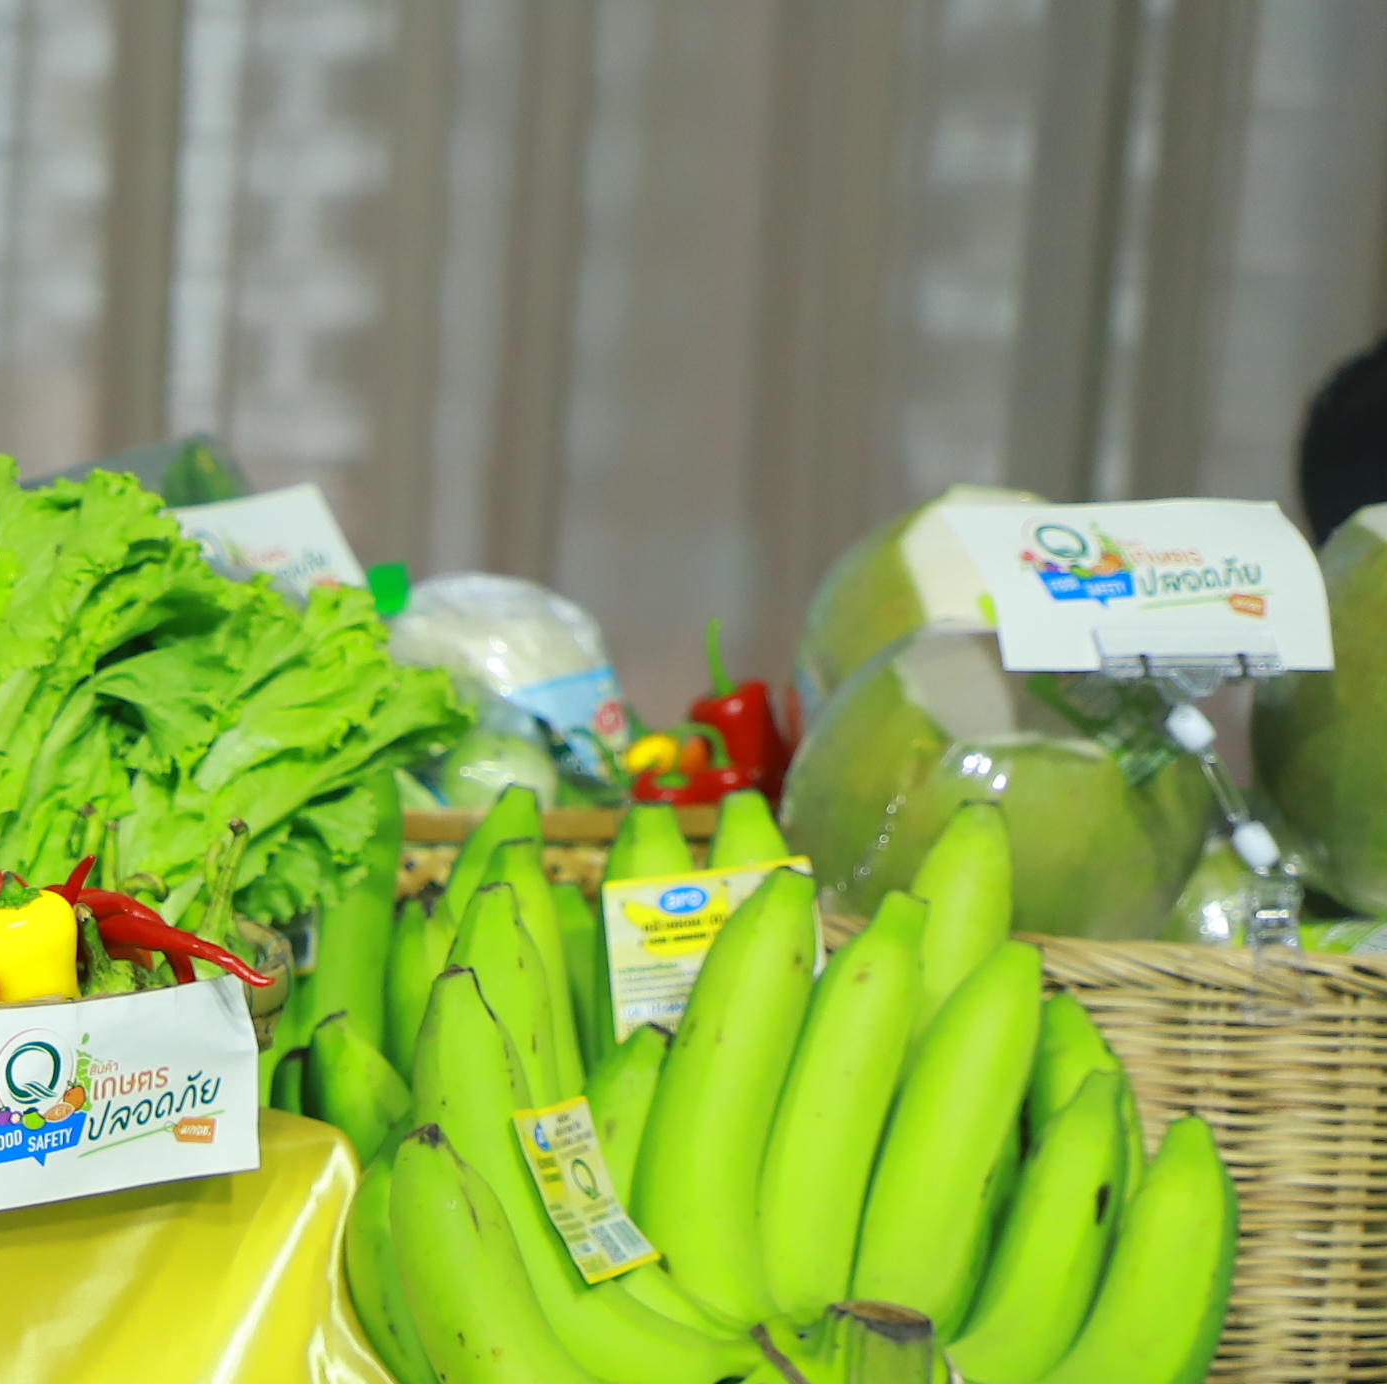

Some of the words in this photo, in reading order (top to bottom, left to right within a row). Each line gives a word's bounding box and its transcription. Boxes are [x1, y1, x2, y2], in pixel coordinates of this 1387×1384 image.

[5, 1040, 59, 1105] Q
[89, 1059, 120, 1077] สินค้า
[93, 1065, 170, 1101] เกษตร
[87, 1069, 222, 1141] ปลอดภัย
[27, 1126, 74, 1153] SAFETY
